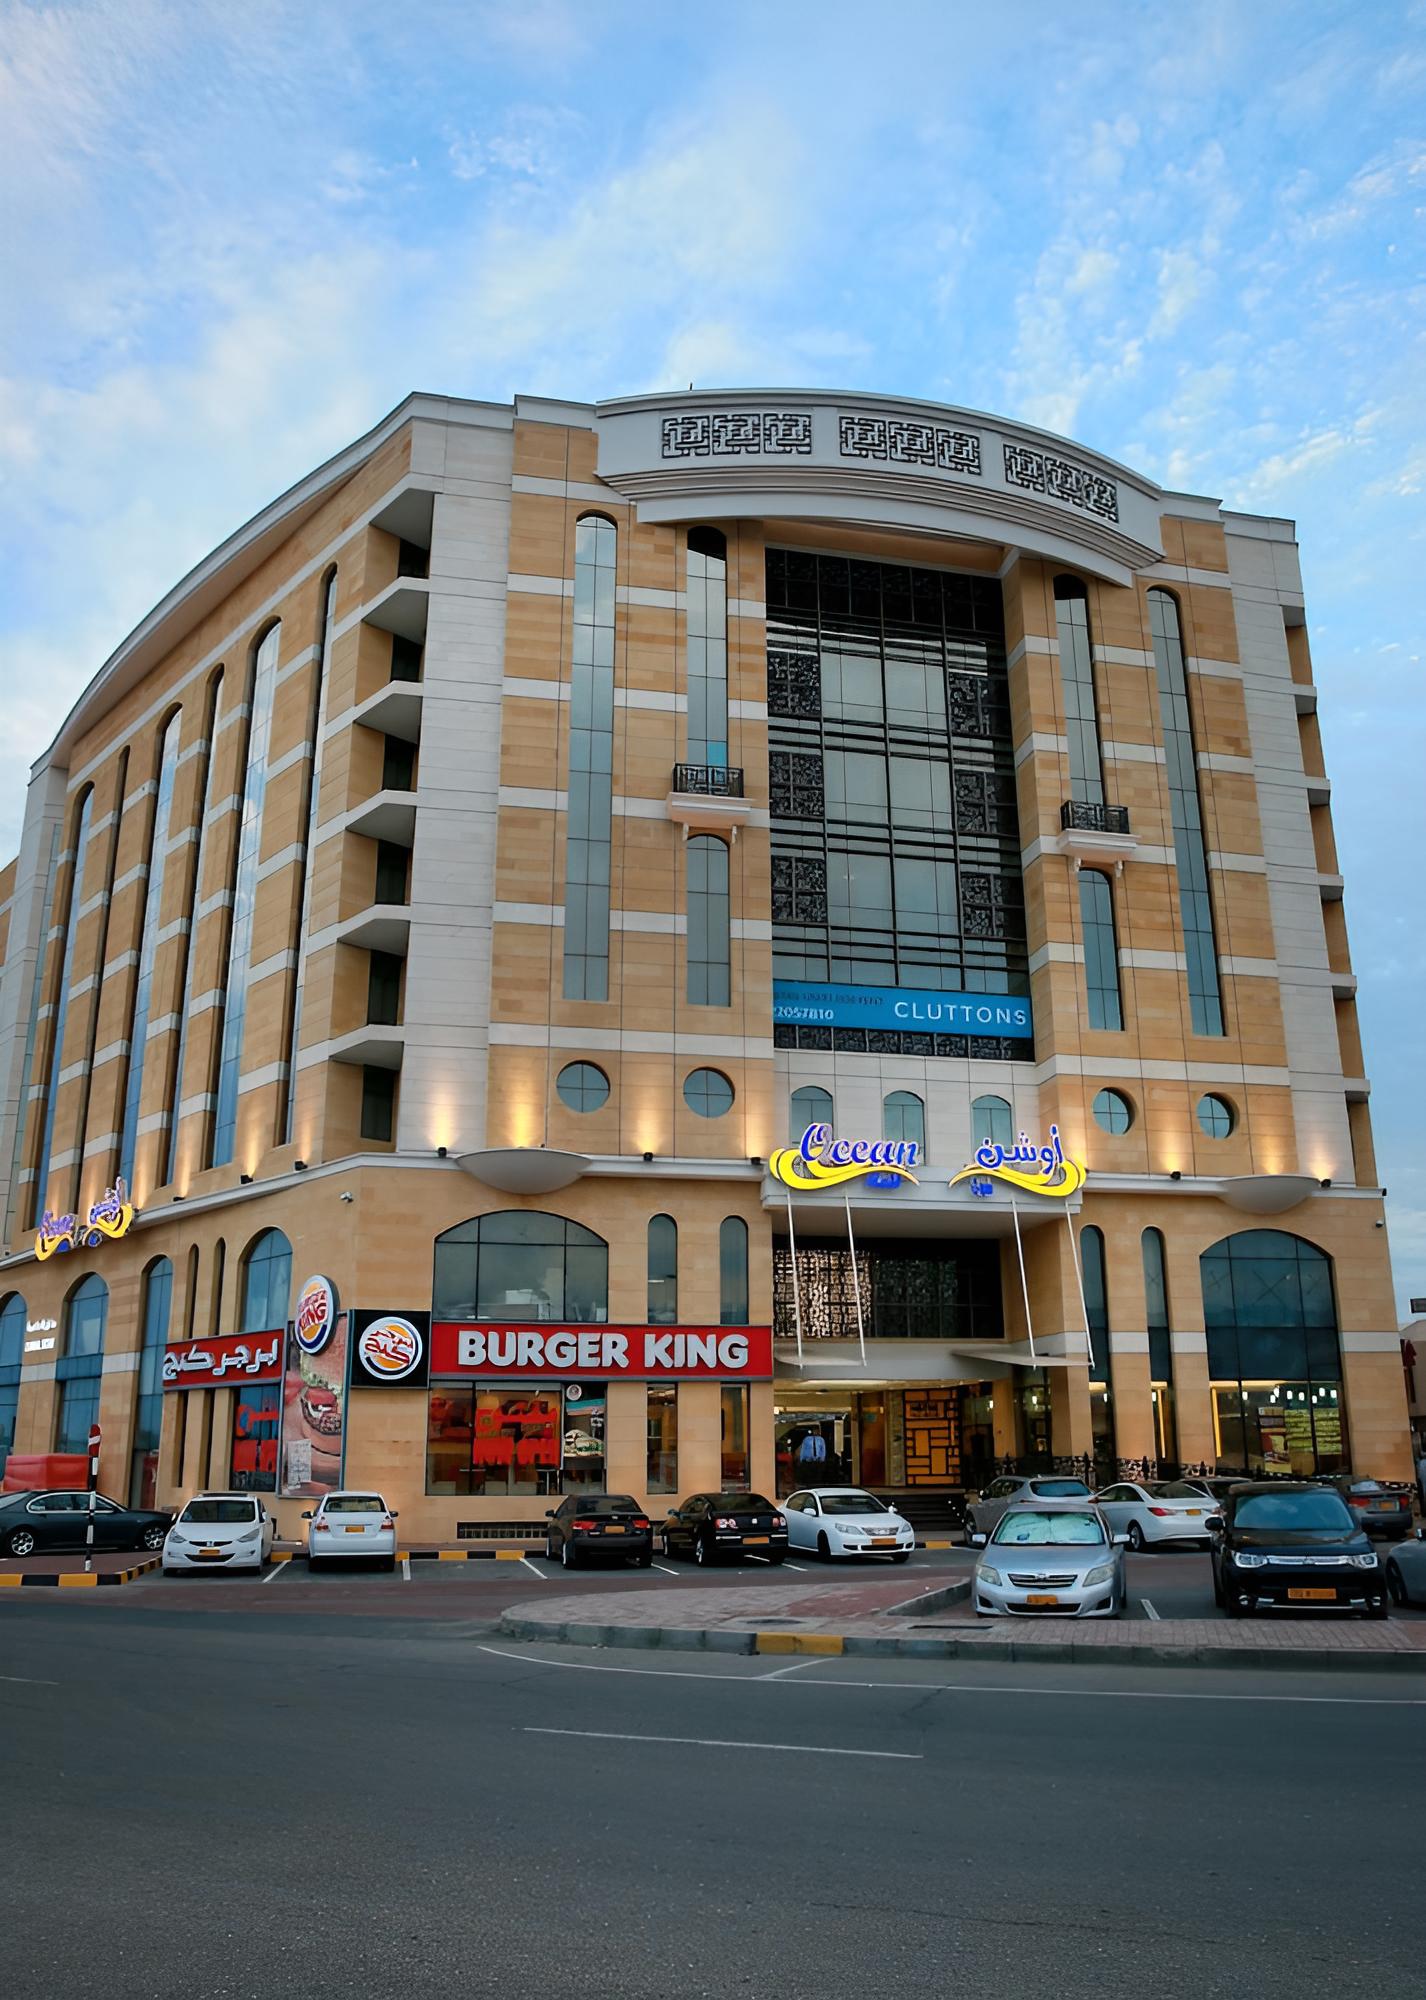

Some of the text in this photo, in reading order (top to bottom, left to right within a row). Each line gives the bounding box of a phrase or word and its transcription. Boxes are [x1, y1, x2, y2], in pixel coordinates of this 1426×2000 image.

[894, 1001, 1027, 1025] CLUTTONS
[799, 1123, 919, 1166] Ocean
[974, 1124, 1063, 1176] أوشن
[458, 1330, 749, 1369] BURGER KING
